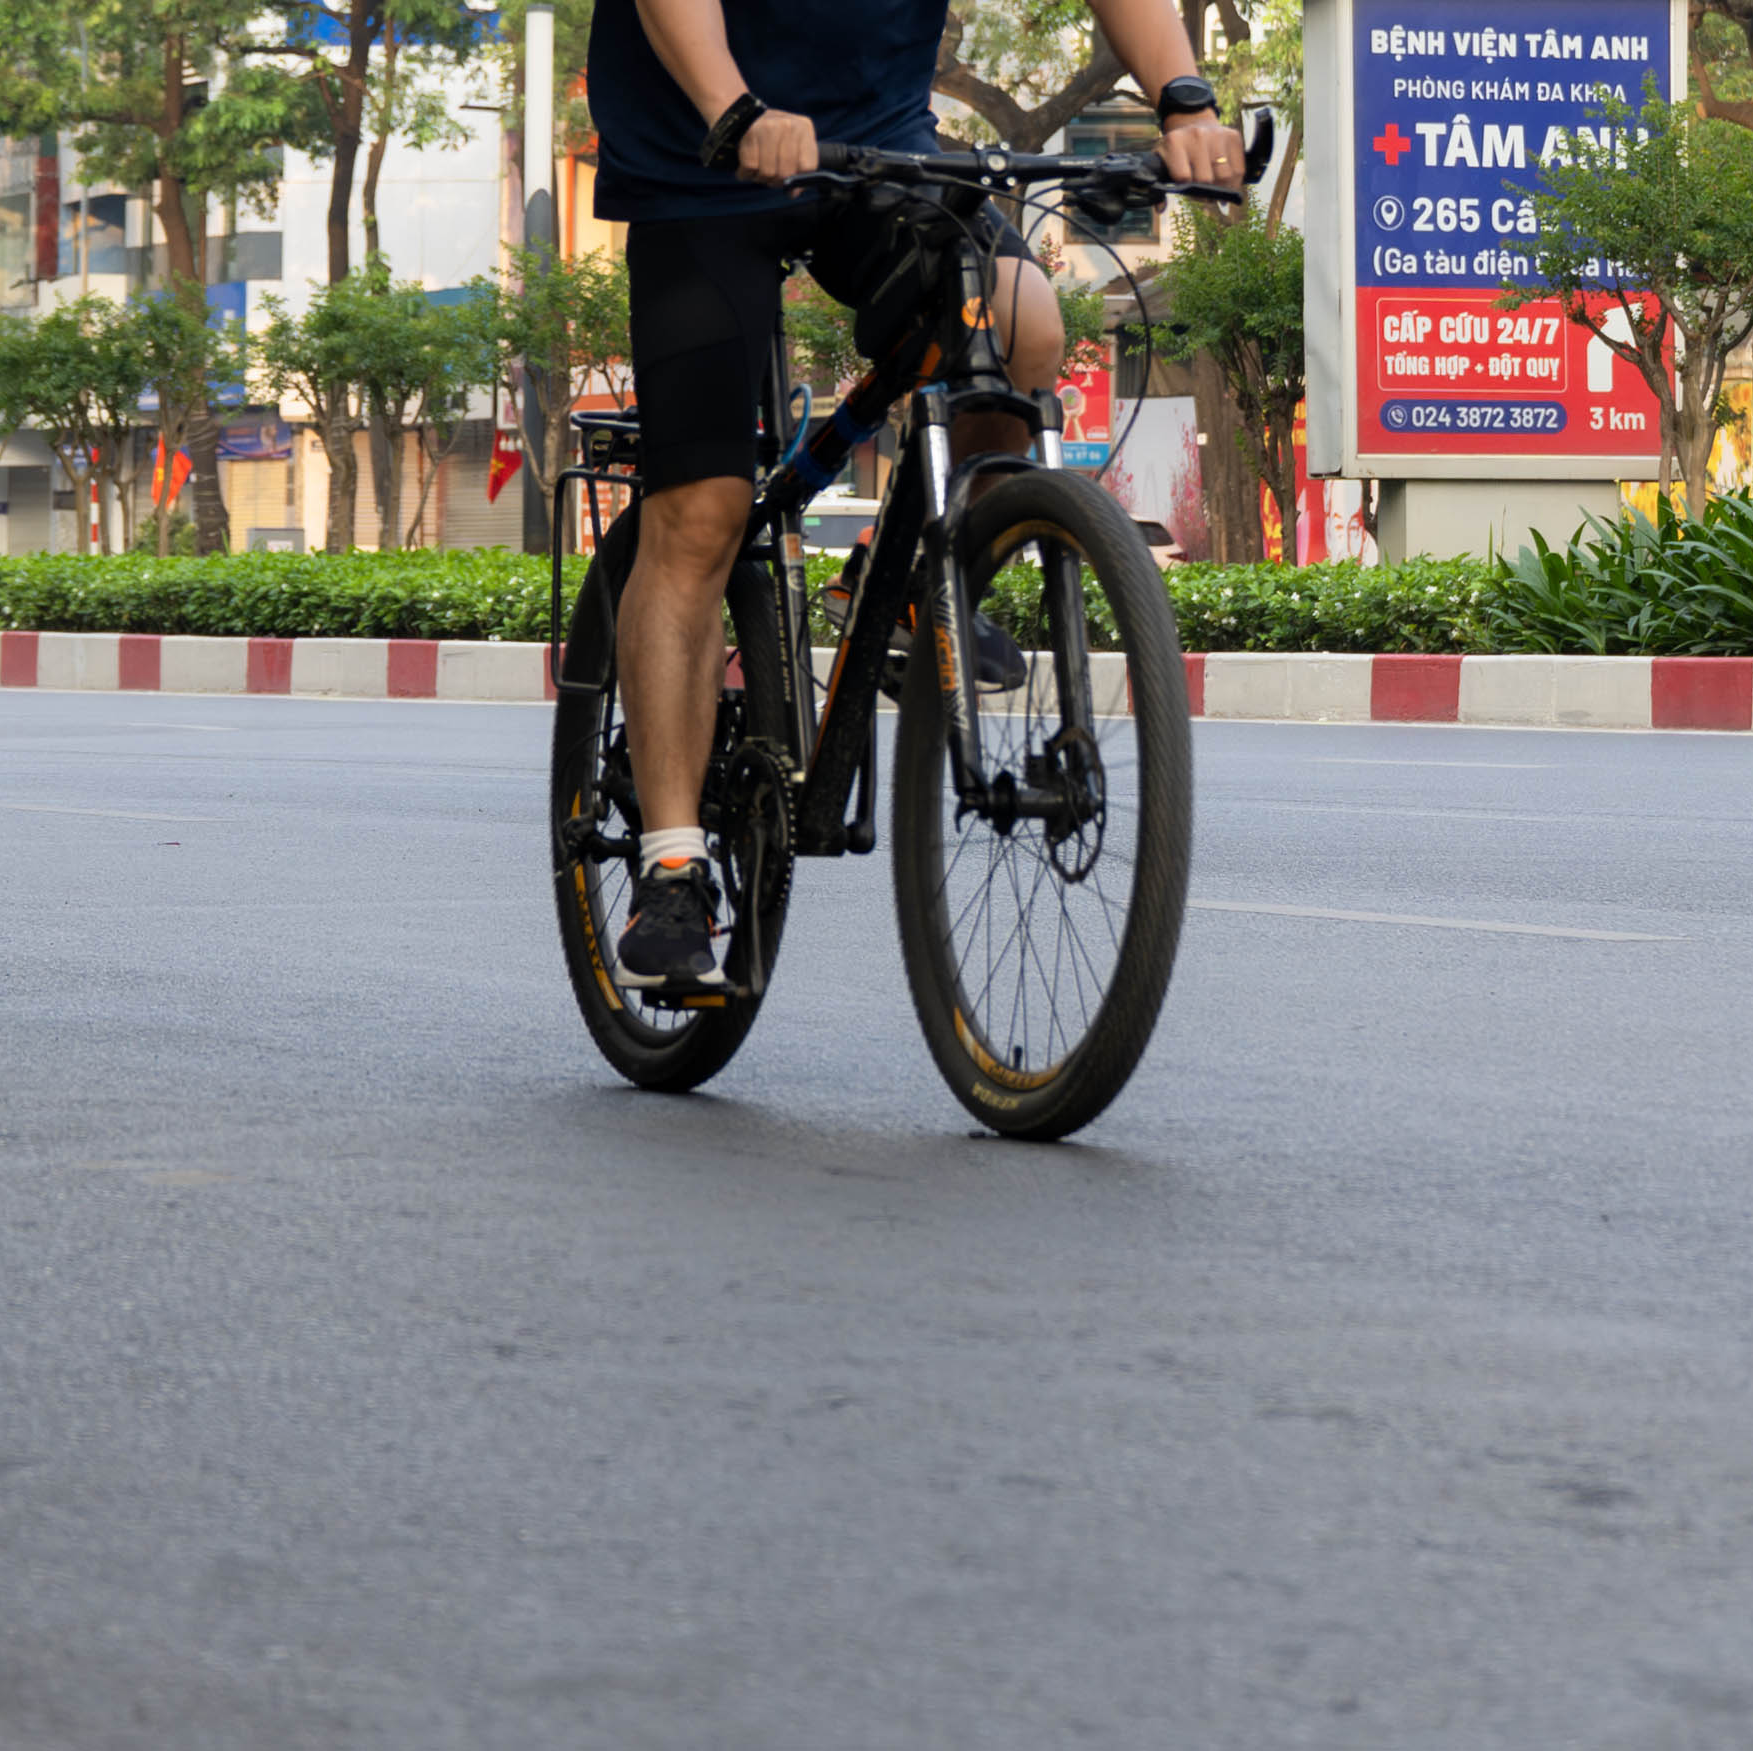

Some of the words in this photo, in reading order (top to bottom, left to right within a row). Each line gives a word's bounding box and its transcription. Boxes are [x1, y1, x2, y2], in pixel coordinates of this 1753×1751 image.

[1371, 24, 1445, 62] BỆNH
[1453, 27, 1518, 64] VIỆN
[1524, 28, 1583, 59] TÂM
[1590, 36, 1648, 61] ANH
[1394, 75, 1465, 99] PHÒNG
[1471, 76, 1530, 101] KHÁM
[1537, 83, 1564, 102] ĐA
[1415, 113, 1526, 168] TÂM
[1413, 197, 1481, 233] 265
[1373, 246, 1417, 276] (Ga
[1423, 250, 1466, 275] tàu
[1473, 249, 1529, 281] điện
[1383, 310, 1432, 343] CẤP
[1439, 311, 1490, 344] CỨU
[1497, 317, 1560, 345] 24/7
[1435, 355, 1470, 380] HỢP
[1488, 353, 1522, 381] ĐỘT
[1412, 406, 1451, 427] 024
[1456, 406, 1505, 428] 3872
[1510, 407, 1559, 429] 3872
[1589, 407, 1604, 430] 3
[1609, 408, 1646, 430] km
